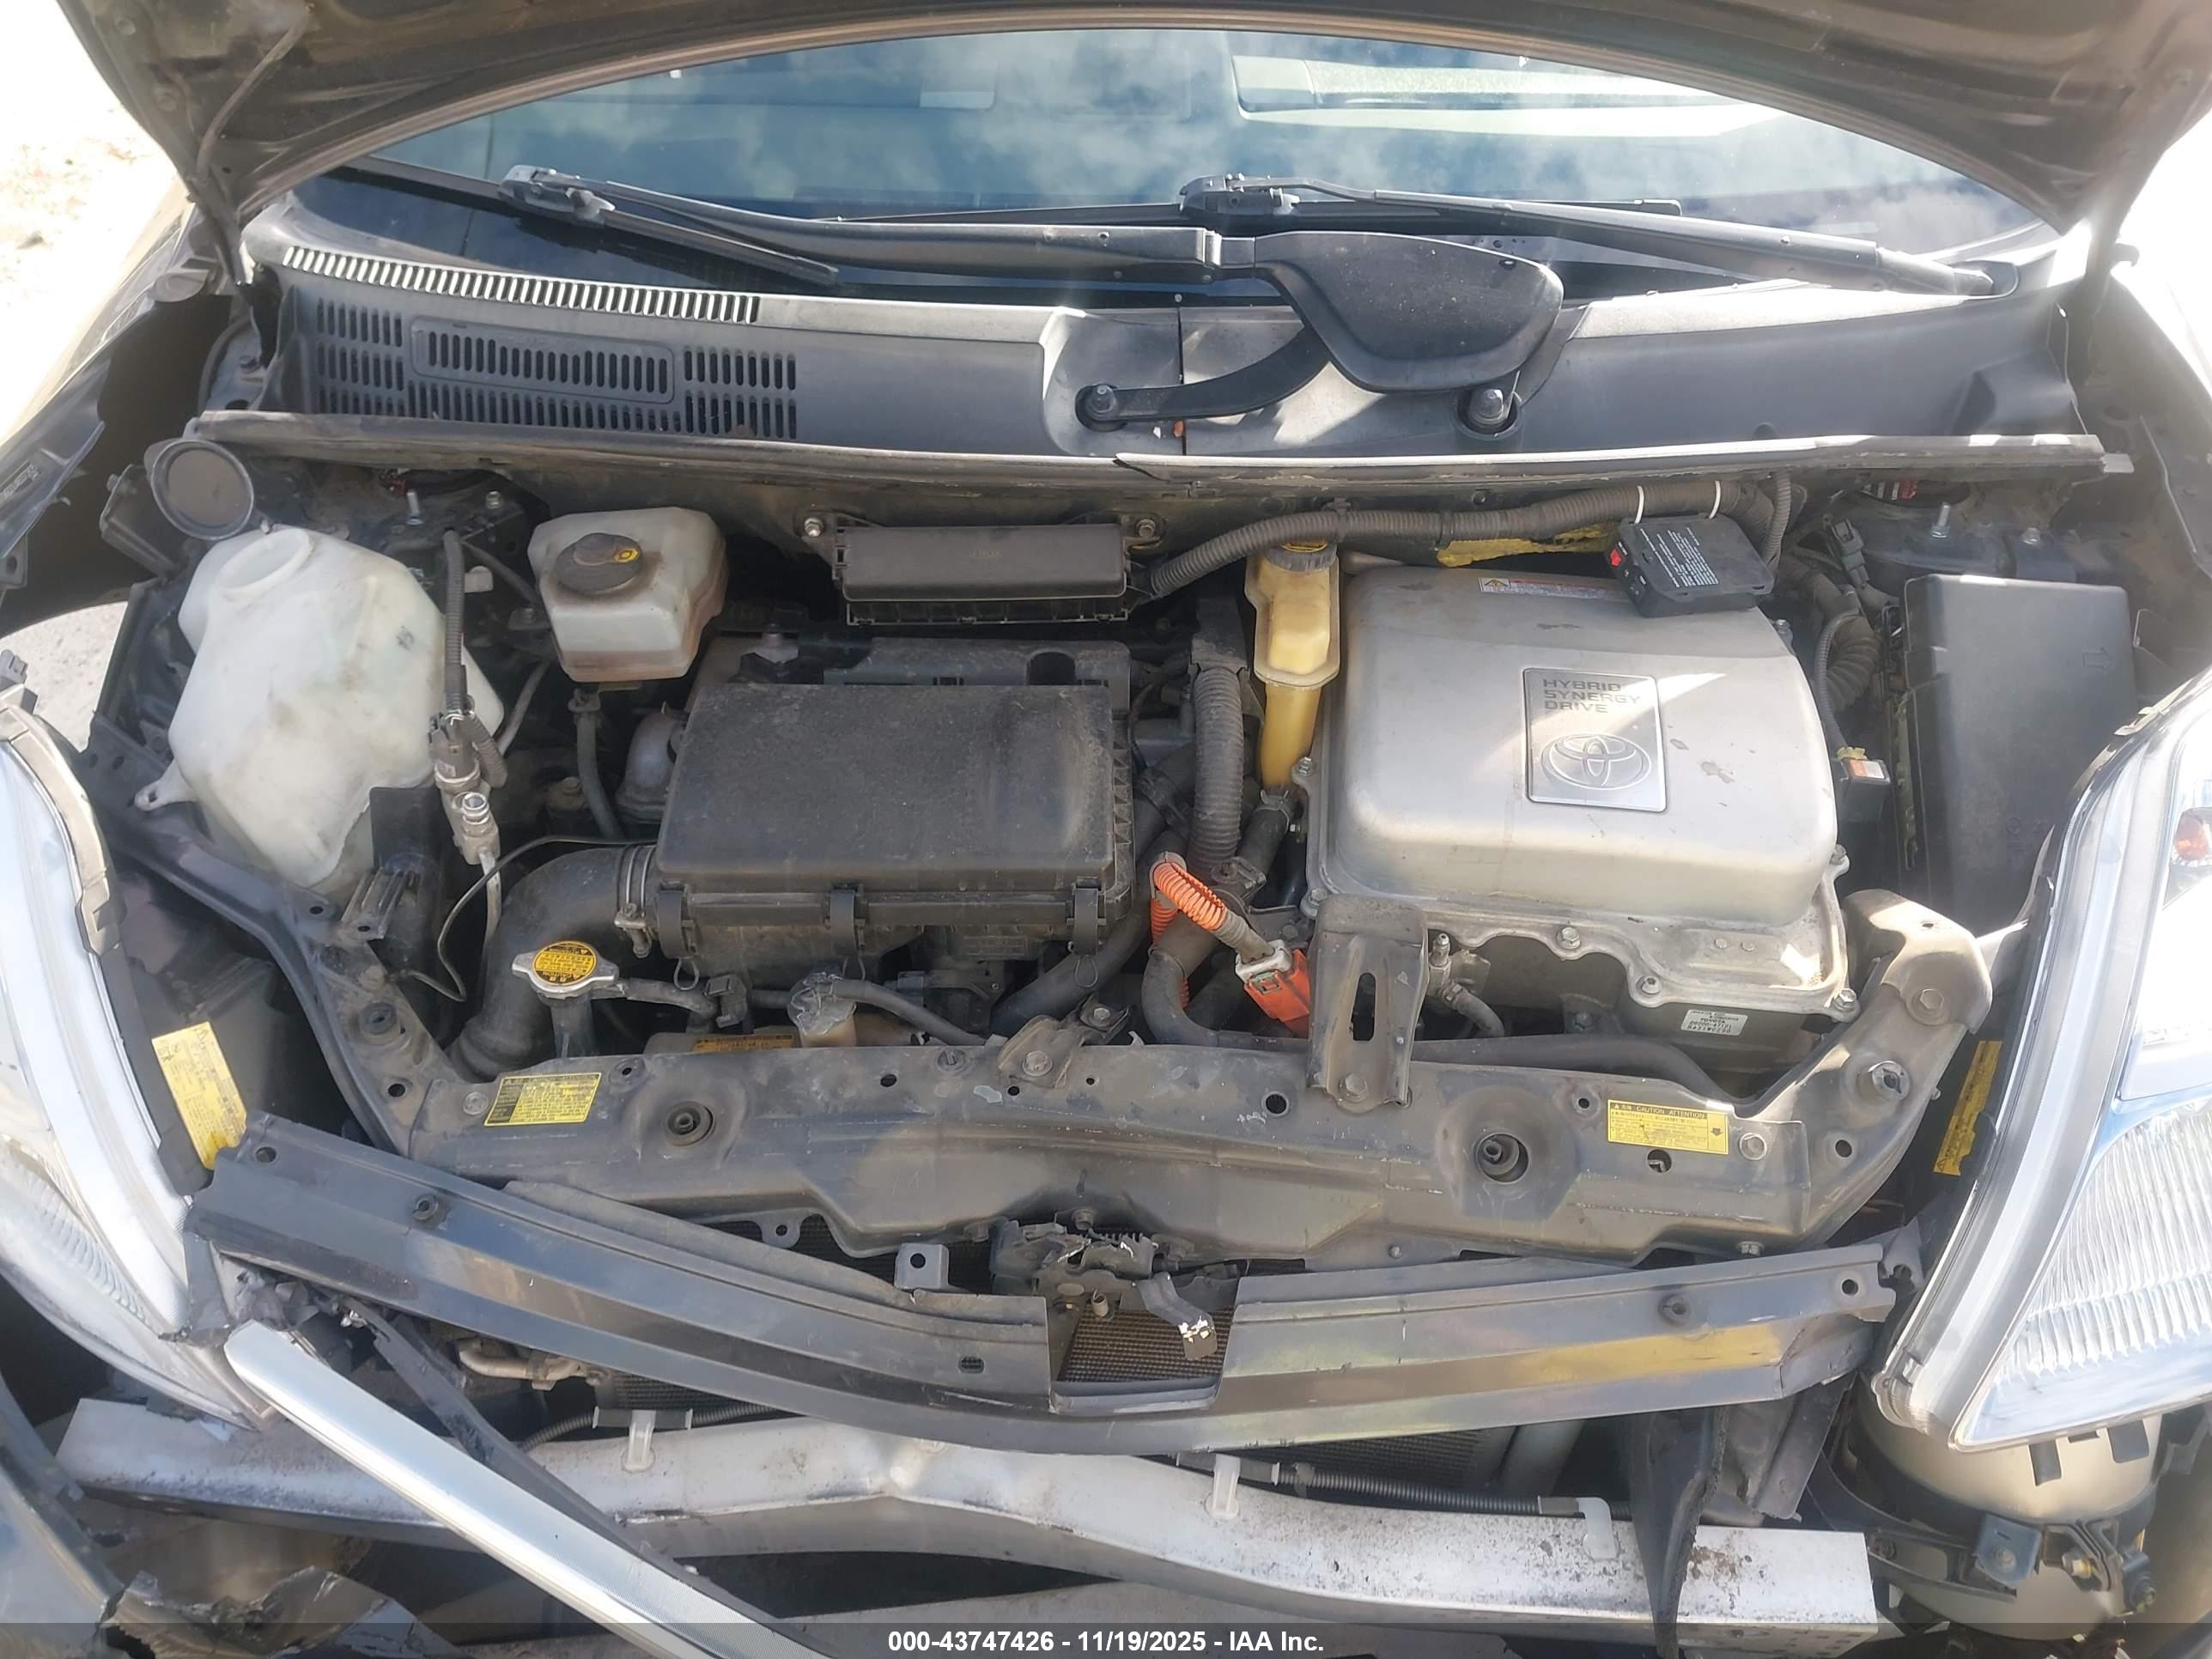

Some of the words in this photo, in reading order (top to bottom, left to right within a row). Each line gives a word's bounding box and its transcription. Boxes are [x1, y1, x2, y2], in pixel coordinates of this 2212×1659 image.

[1543, 679, 1621, 692] HYBRID
[1544, 690, 1641, 704] SYNERGY
[1544, 701, 1607, 714] DRIVE
[1636, 1105, 1665, 1115] CAUTION
[1668, 1110, 1705, 1119] ATTENTION
